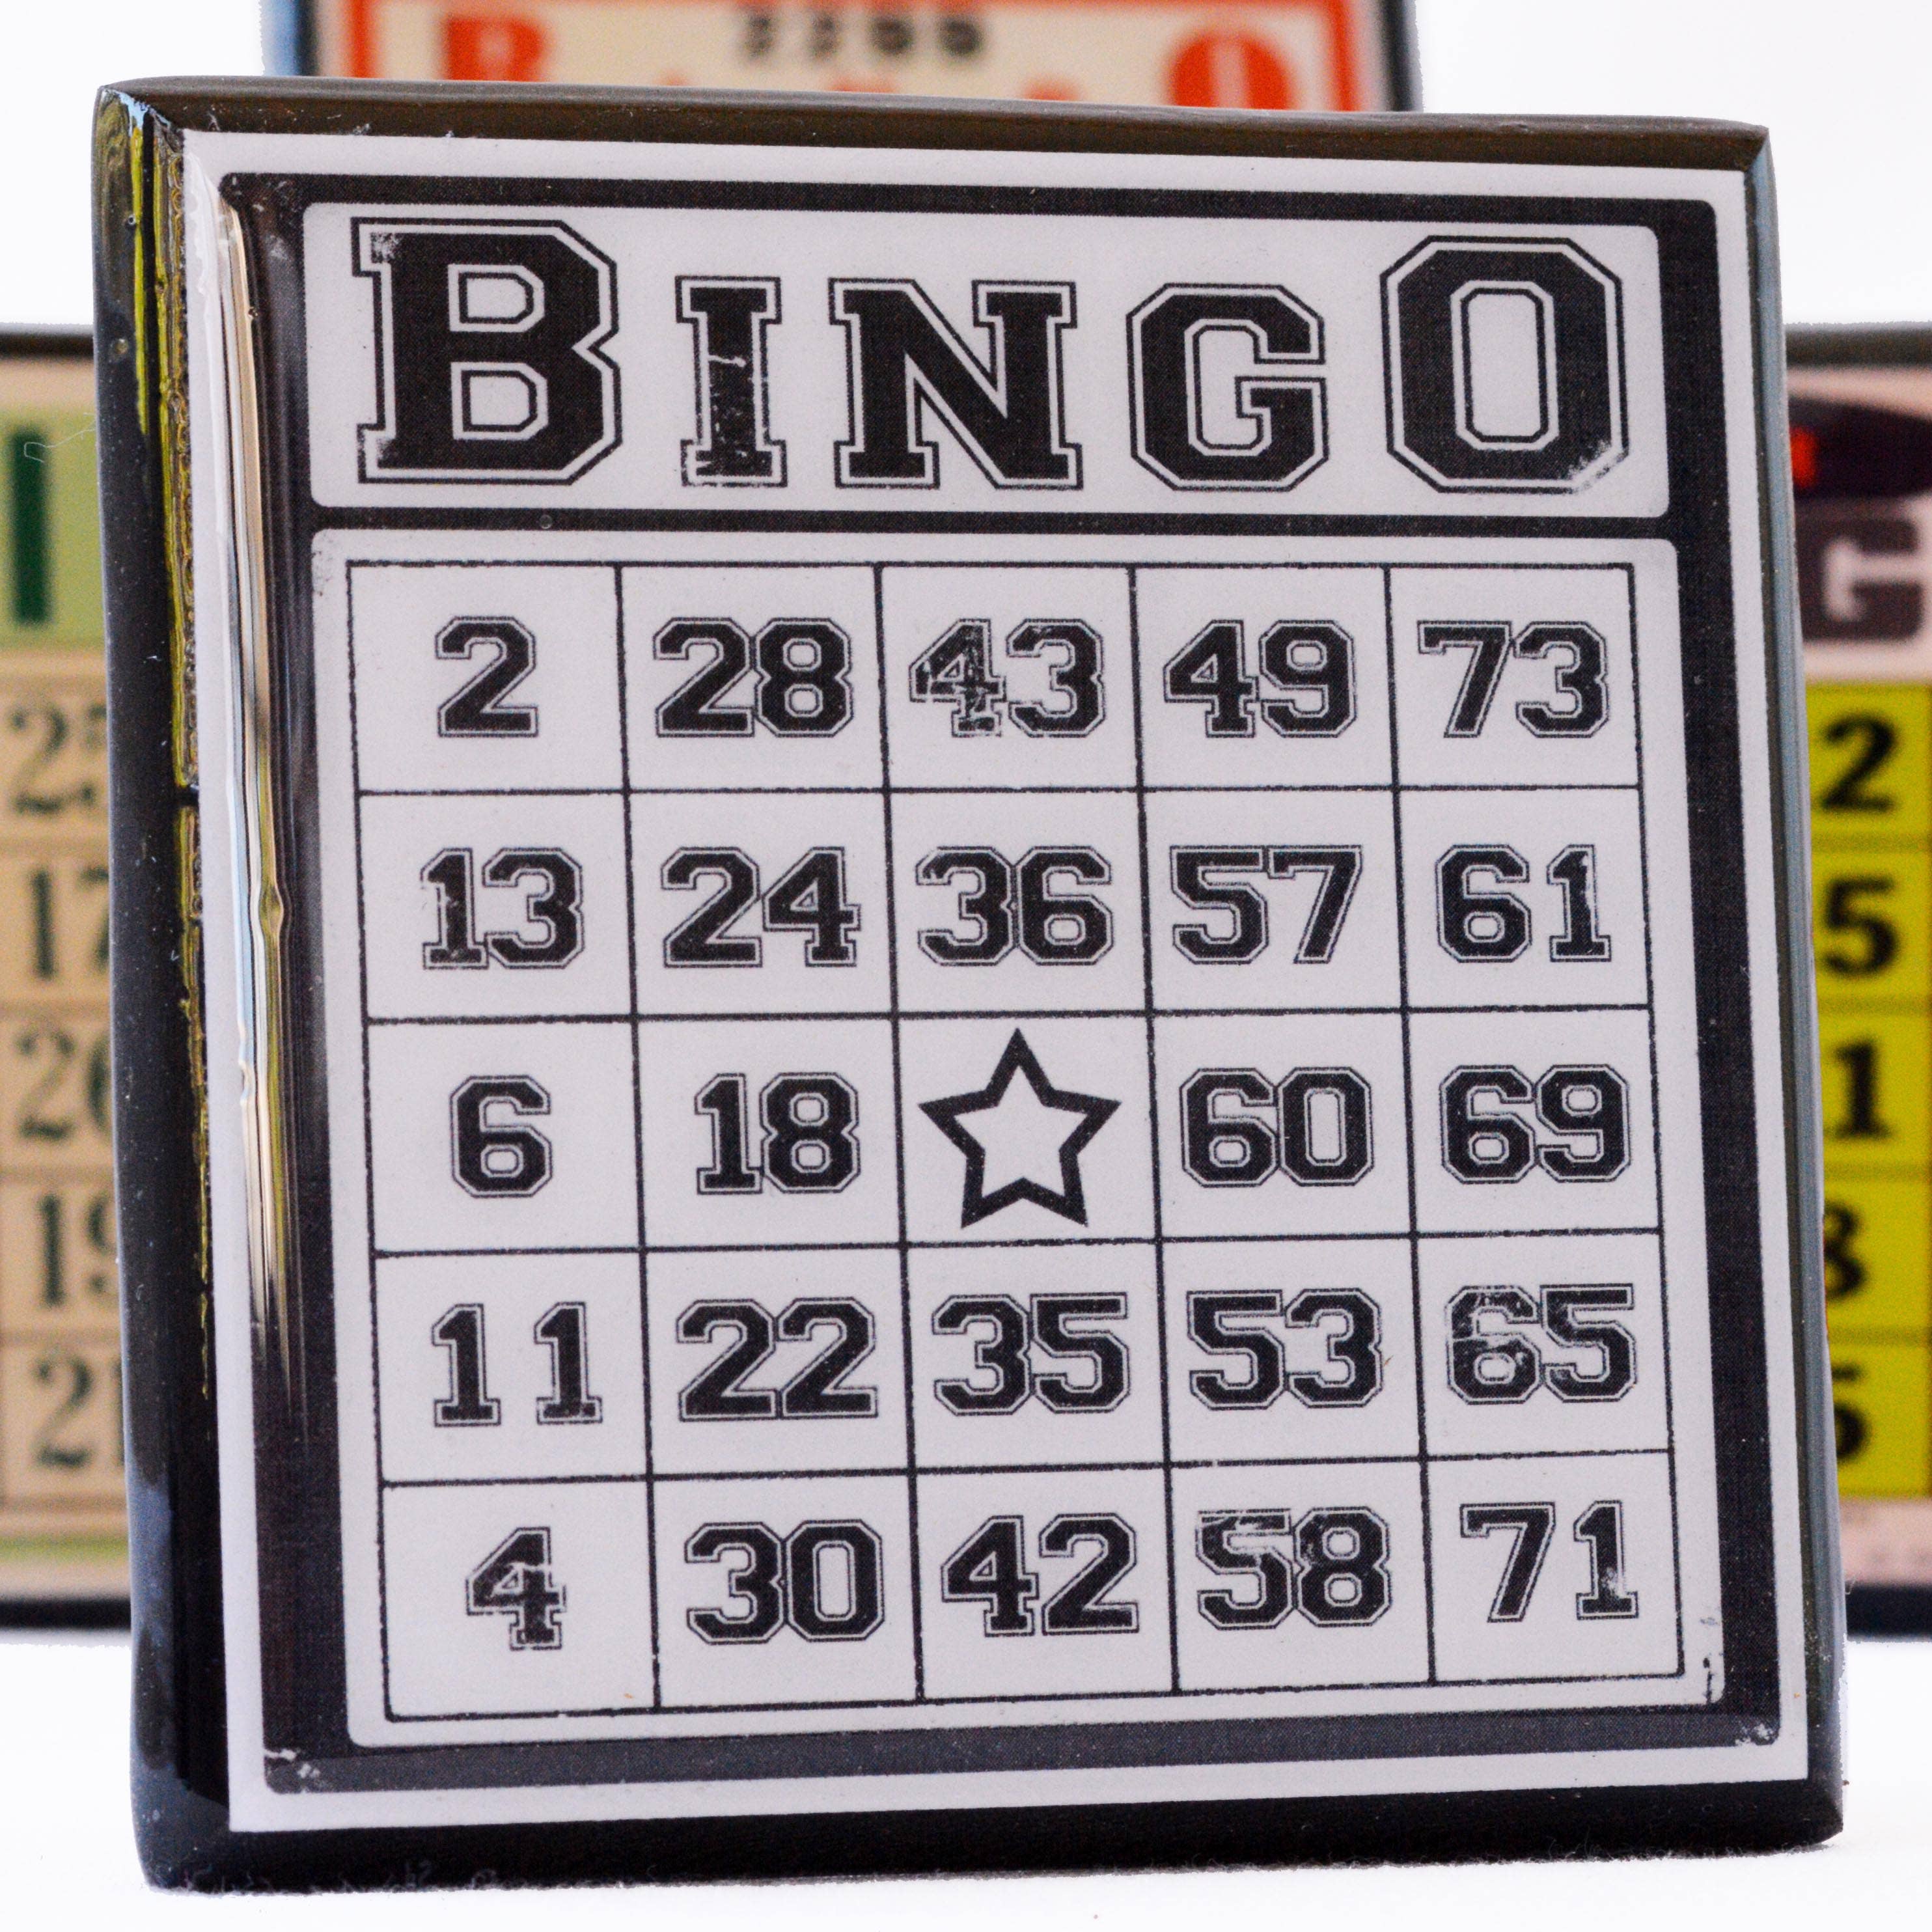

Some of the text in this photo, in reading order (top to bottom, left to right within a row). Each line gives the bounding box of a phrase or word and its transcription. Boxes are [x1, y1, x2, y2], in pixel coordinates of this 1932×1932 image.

[356, 217, 1630, 492] BINGO
[435, 616, 1609, 738] 2 28 43 49 73
[421, 844, 1612, 970] 13 24 36 57 61
[450, 1064, 1631, 1198] 6 18 60 69
[432, 1283, 1637, 1427] 11 22 35 53 65
[465, 1500, 1639, 1651] 4 30 42 58 71
